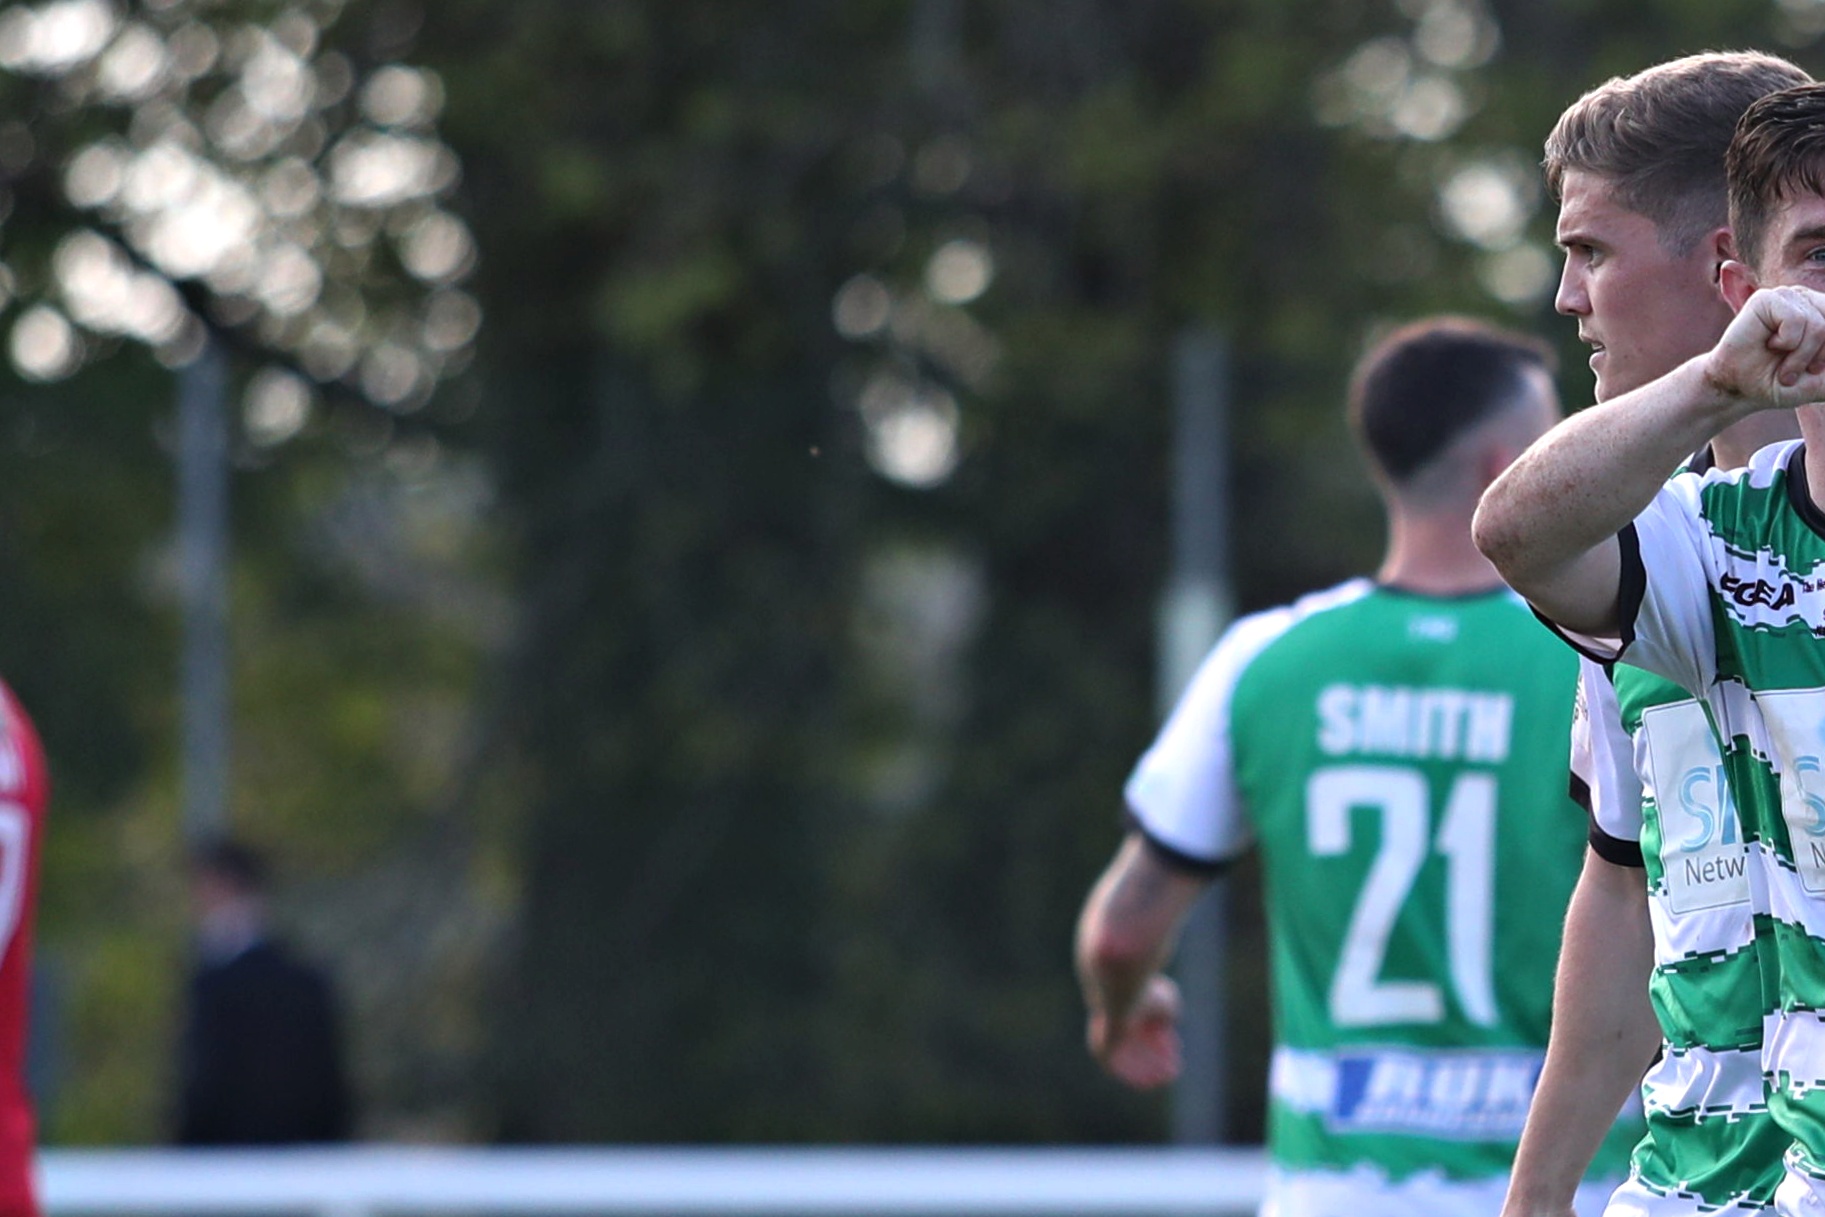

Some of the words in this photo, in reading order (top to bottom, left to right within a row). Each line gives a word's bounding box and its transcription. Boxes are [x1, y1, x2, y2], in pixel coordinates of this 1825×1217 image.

[1720, 572, 1795, 611] EGEA
[1315, 683, 1514, 763] SMITH
[1306, 764, 1498, 1028] 21
[1685, 855, 1746, 886] Netw
